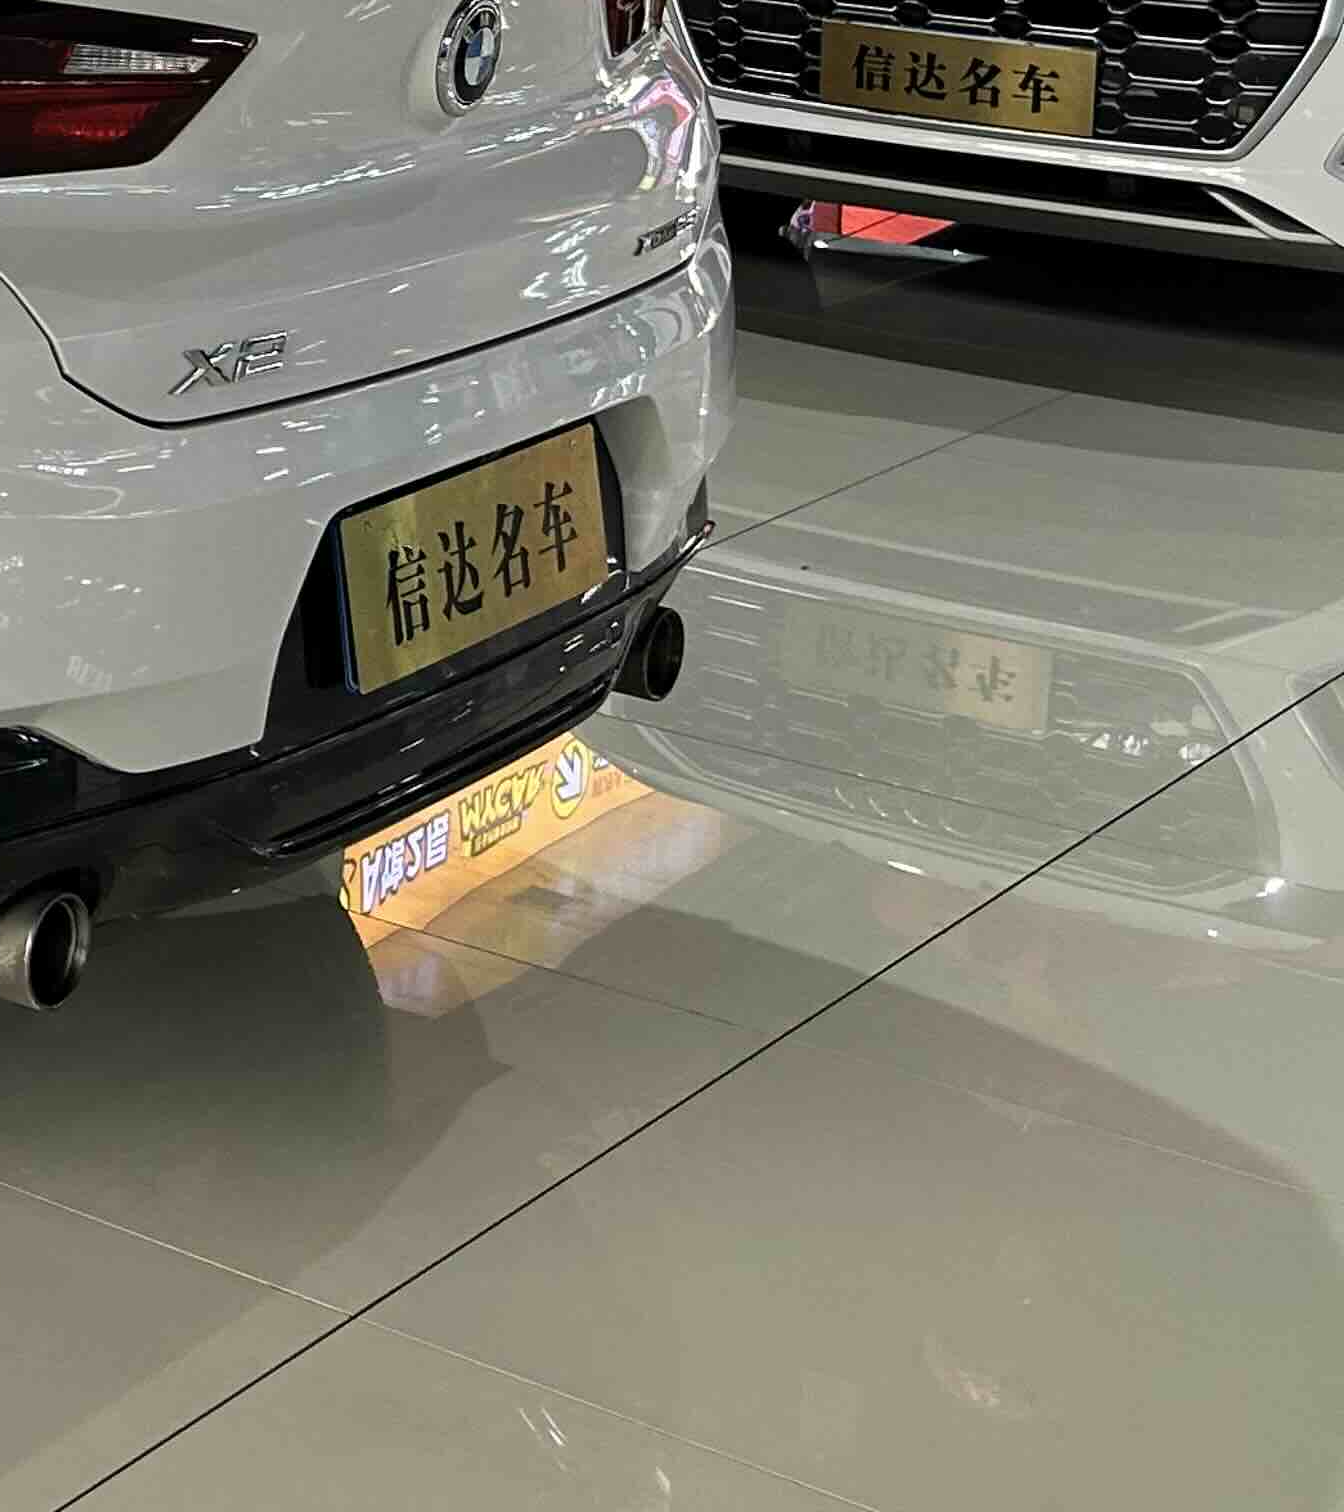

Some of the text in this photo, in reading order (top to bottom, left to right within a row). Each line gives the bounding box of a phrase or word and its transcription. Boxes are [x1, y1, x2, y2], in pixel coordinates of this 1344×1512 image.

[851, 42, 1062, 115] 信达名车
[169, 328, 288, 396] X2
[384, 478, 579, 649] 信达名车
